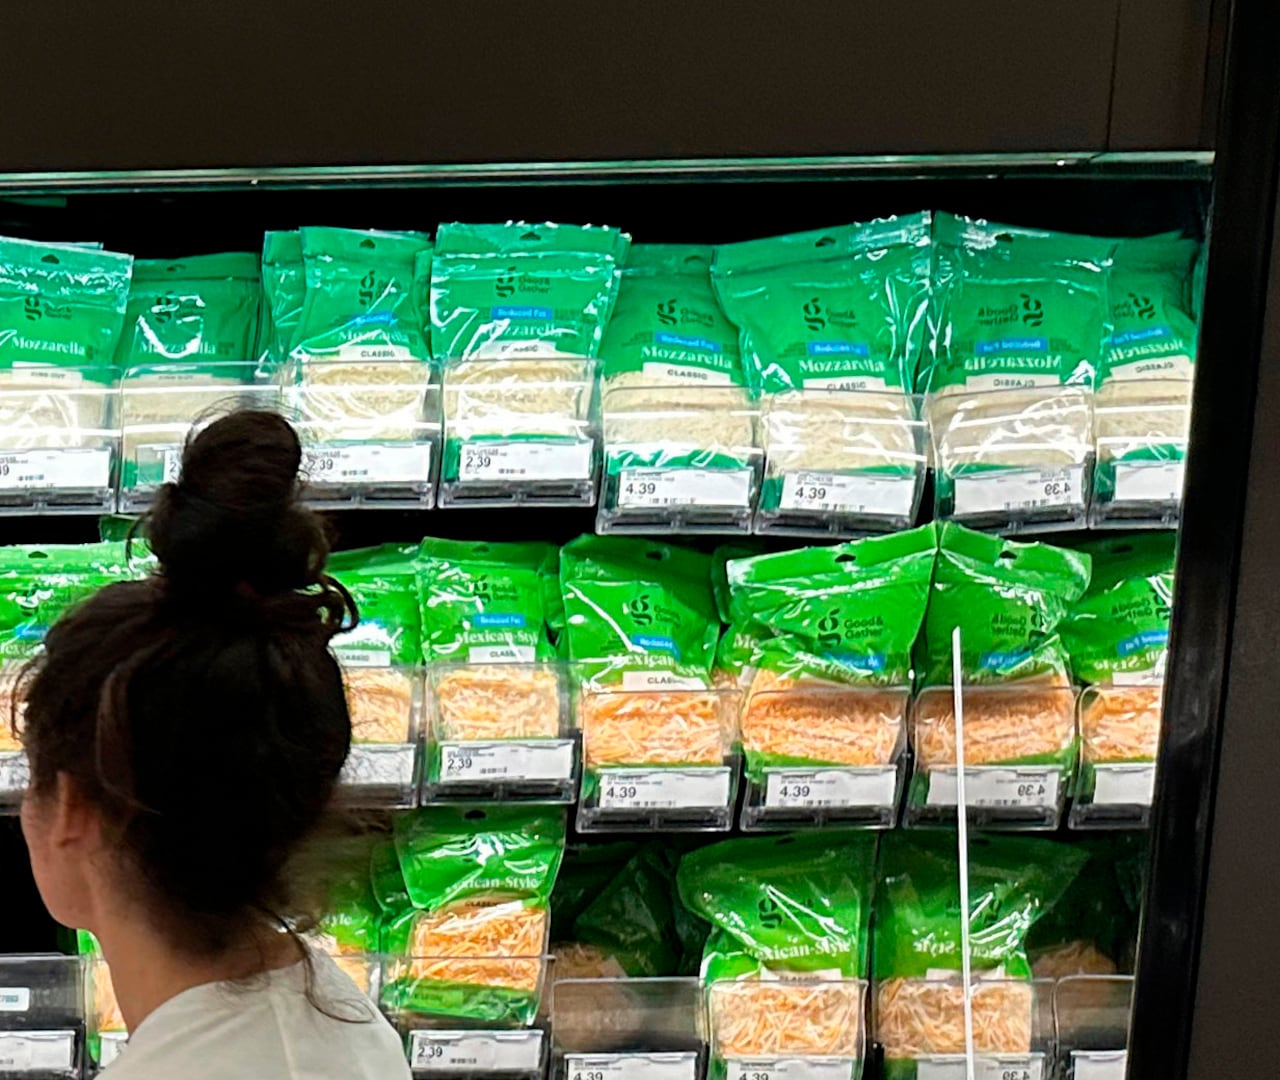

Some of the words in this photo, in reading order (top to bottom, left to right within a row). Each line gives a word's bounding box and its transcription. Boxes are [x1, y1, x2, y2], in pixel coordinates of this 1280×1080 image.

[12, 336, 86, 356] Mozzarella
[641, 345, 733, 368] Mozzarella
[799, 356, 885, 373] Mozzarella
[625, 482, 656, 496] 4.39
[844, 616, 884, 630] Good&
[845, 627, 883, 639] Gather
[606, 785, 636, 799] 4.39
